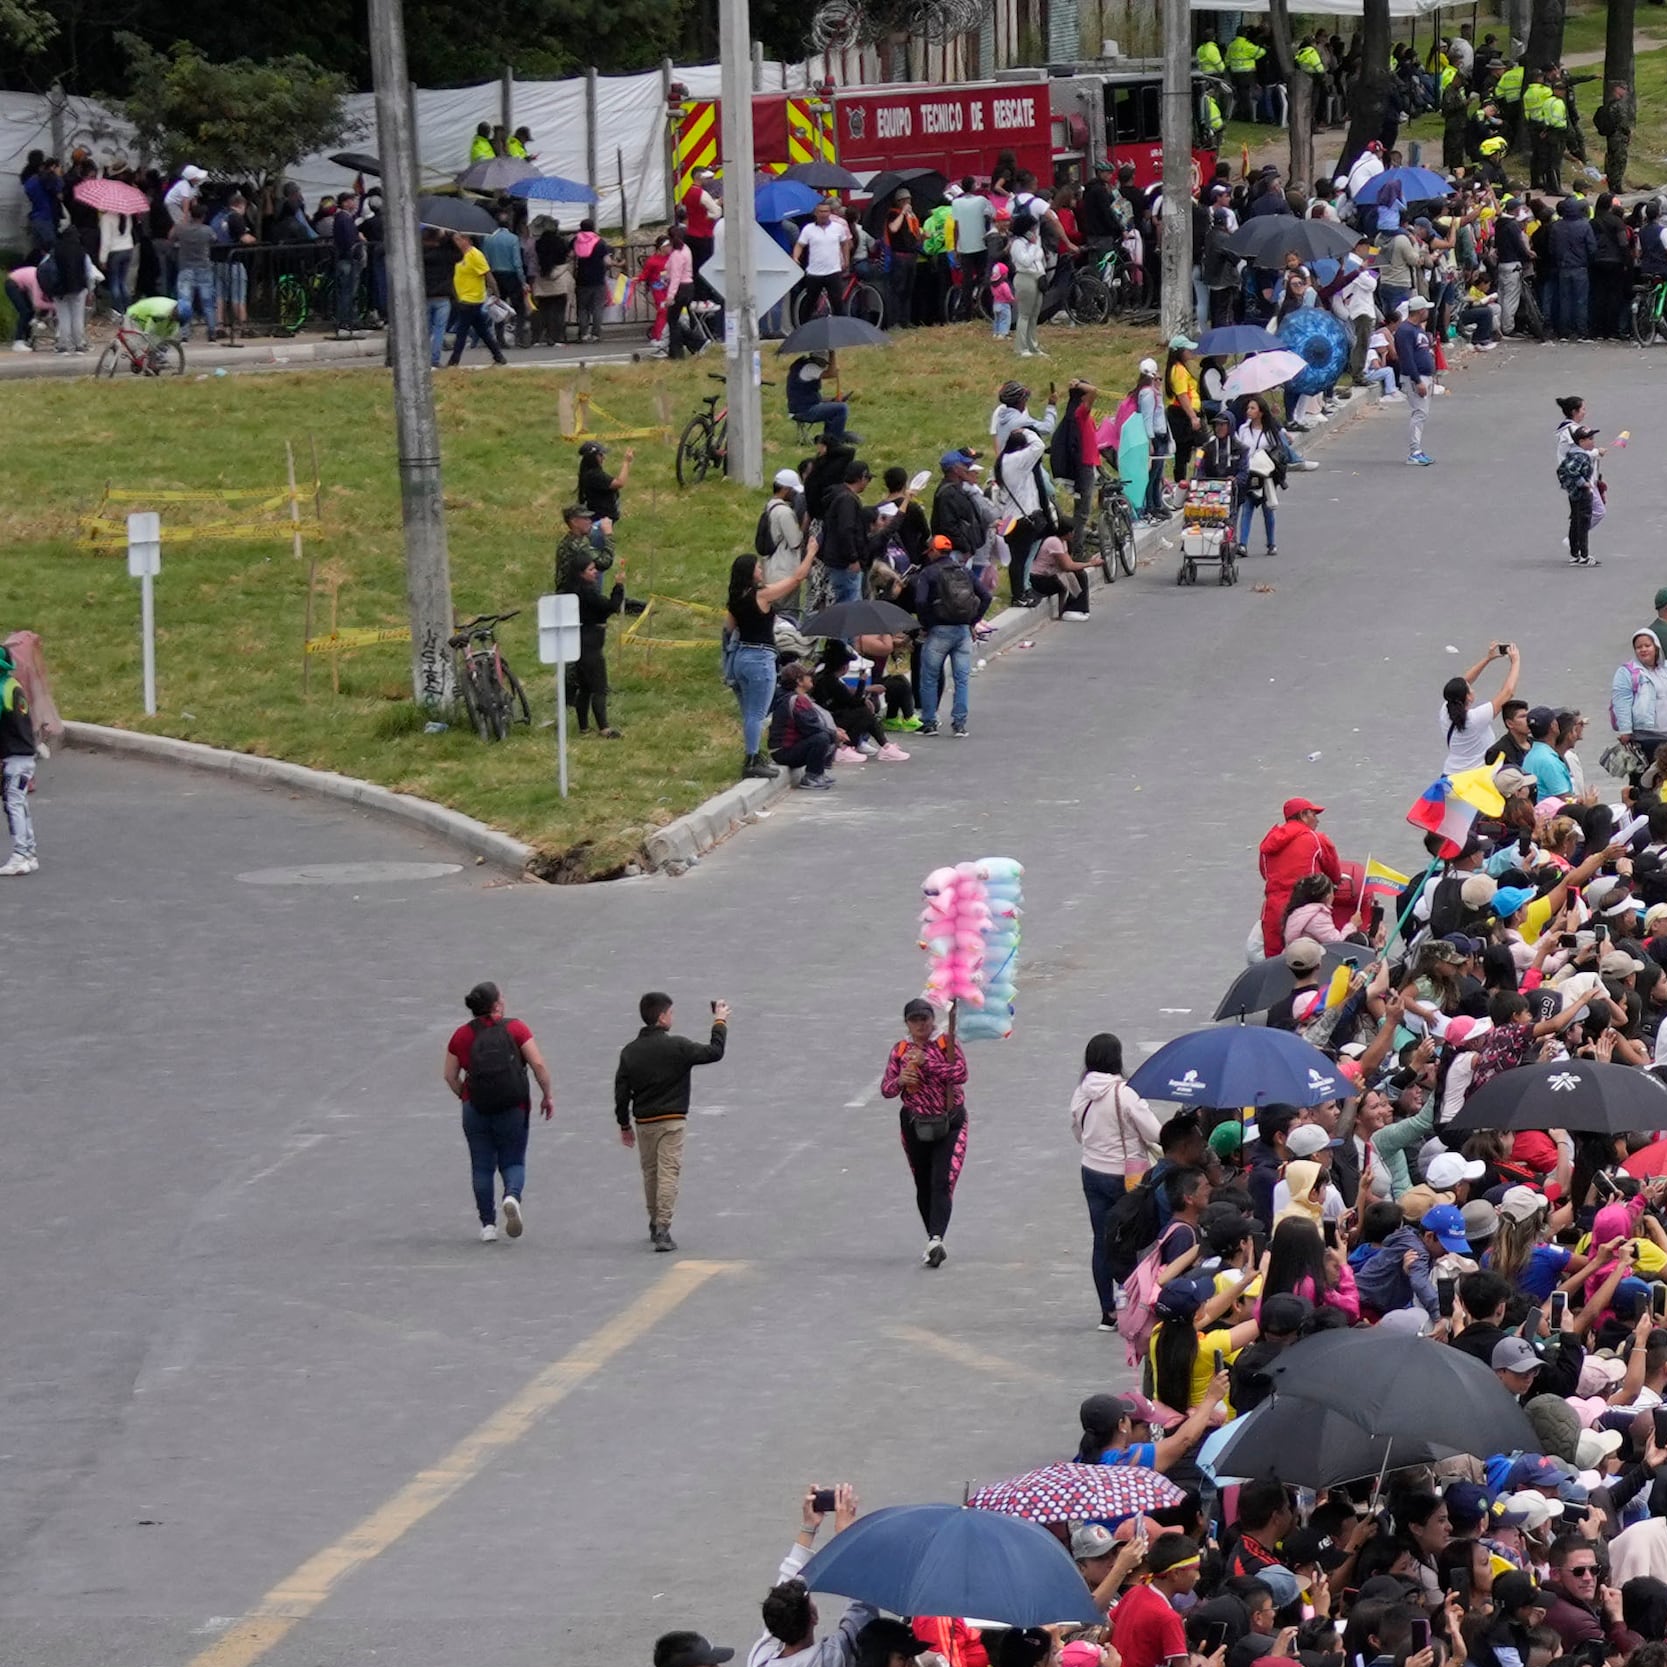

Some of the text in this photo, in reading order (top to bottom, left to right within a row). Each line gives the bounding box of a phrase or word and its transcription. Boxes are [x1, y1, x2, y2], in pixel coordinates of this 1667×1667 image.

[877, 98, 1035, 138] EQUIPO TECNICO DE RESCATE
